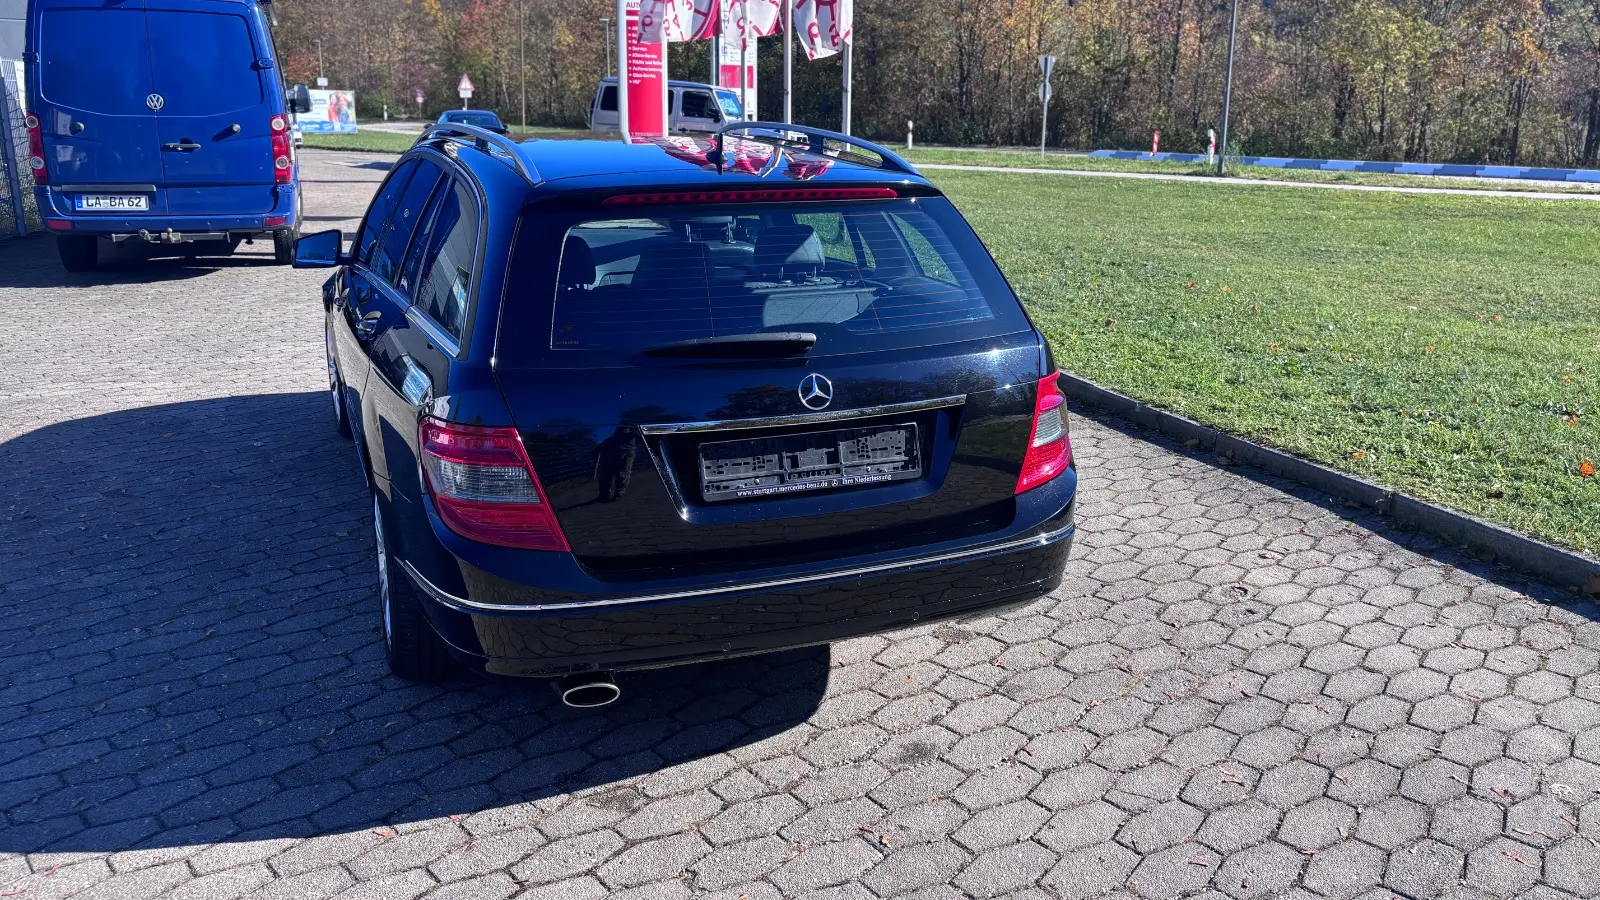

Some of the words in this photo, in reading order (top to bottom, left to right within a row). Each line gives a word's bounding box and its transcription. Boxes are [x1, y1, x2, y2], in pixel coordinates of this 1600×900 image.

[86, 196, 102, 207] LA
[110, 196, 124, 207] BA
[128, 196, 142, 207] 62
